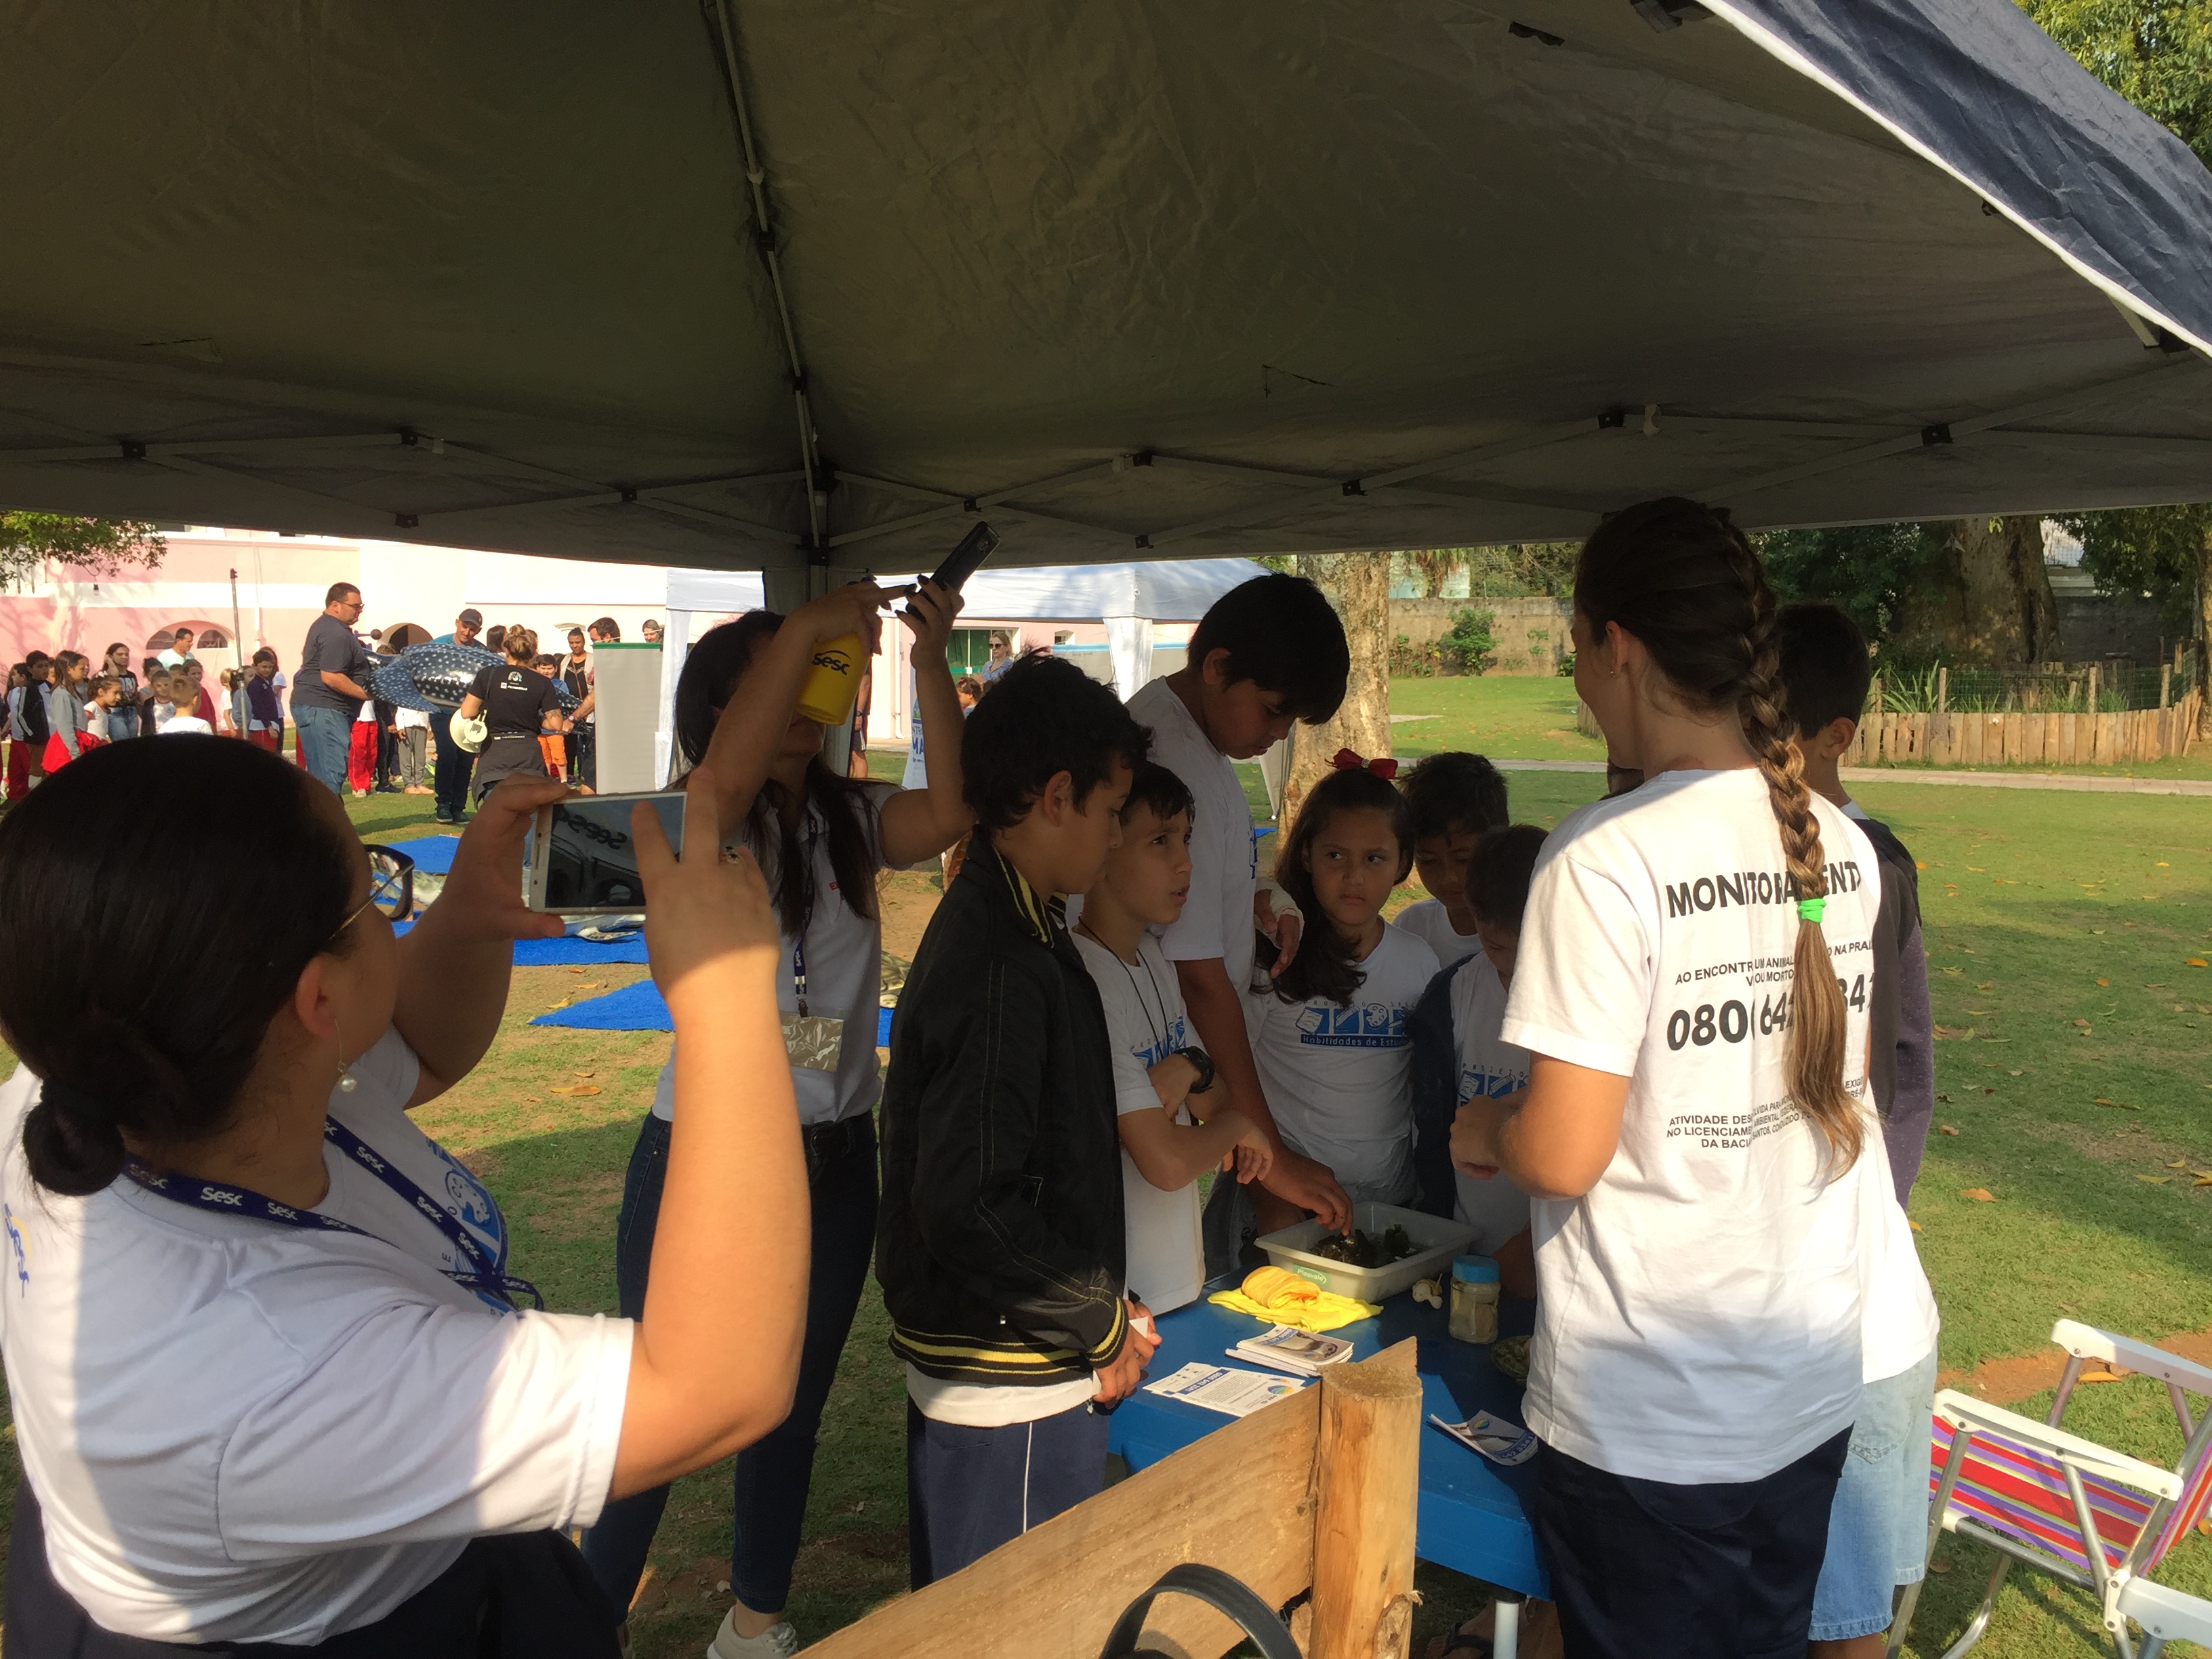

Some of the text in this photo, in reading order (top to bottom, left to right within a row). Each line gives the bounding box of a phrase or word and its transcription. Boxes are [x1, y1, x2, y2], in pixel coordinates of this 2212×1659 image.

[1675, 972, 1692, 985] AO
[1695, 961, 1753, 981] ENCONTR
[1835, 945, 1847, 956] NA
[1303, 1036, 1361, 1046] Habilidades
[1366, 1038, 1376, 1046] de
[1669, 1115, 1728, 1126] ATIVIDADE
[1667, 1128, 1681, 1137] NO
[1685, 1126, 1752, 1136] LICENCIAME
[1701, 1139, 1719, 1147] DA
